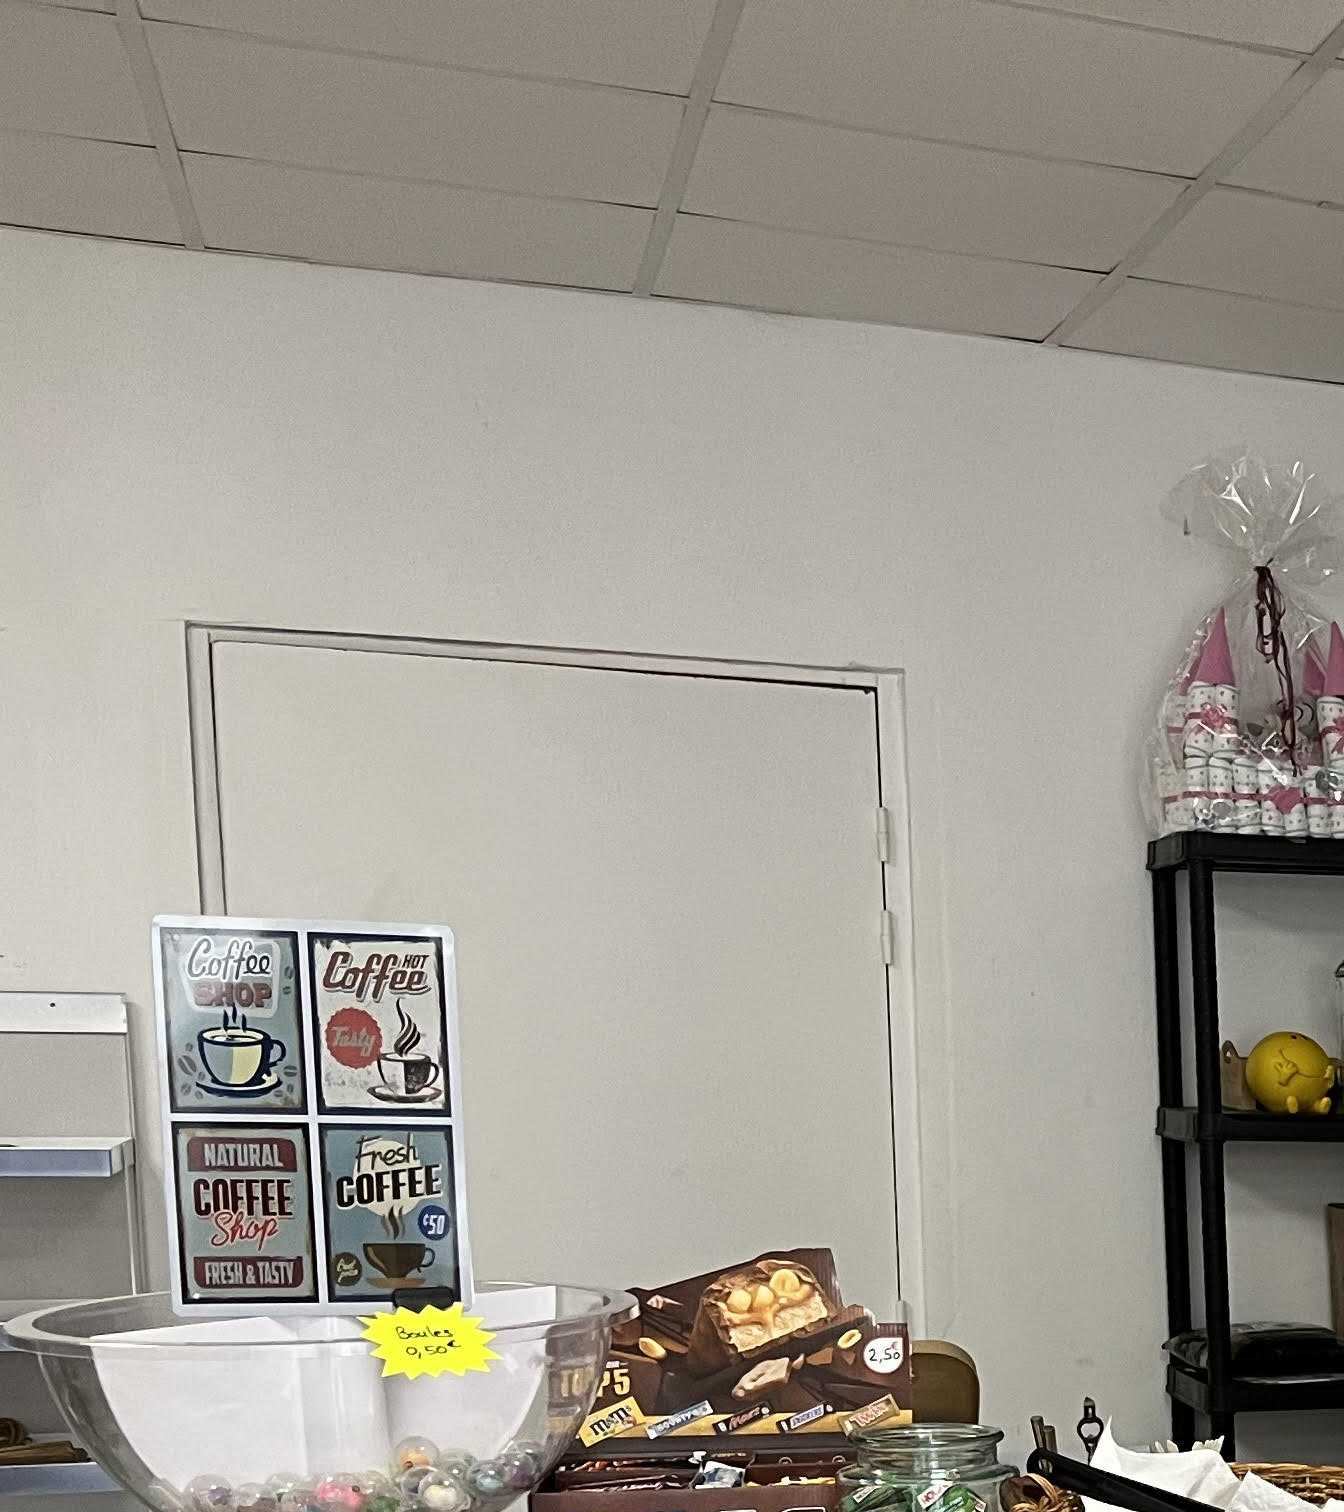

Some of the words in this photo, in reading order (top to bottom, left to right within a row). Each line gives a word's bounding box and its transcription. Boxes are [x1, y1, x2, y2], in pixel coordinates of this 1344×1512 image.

[187, 937, 272, 981] Coffee
[323, 951, 432, 1002] Coffee
[402, 954, 429, 970] HOT
[193, 982, 273, 1007] SHOP
[203, 1142, 284, 1167] NATURAL
[355, 1133, 418, 1173] Fresh
[192, 1178, 294, 1218] COFFEE
[335, 1164, 442, 1209] COFFEE
[209, 1211, 279, 1253] Shop
[204, 1261, 243, 1286] FRESH
[245, 1261, 257, 1285] &
[258, 1261, 295, 1285] TASTY
[395, 1325, 454, 1340] Boules
